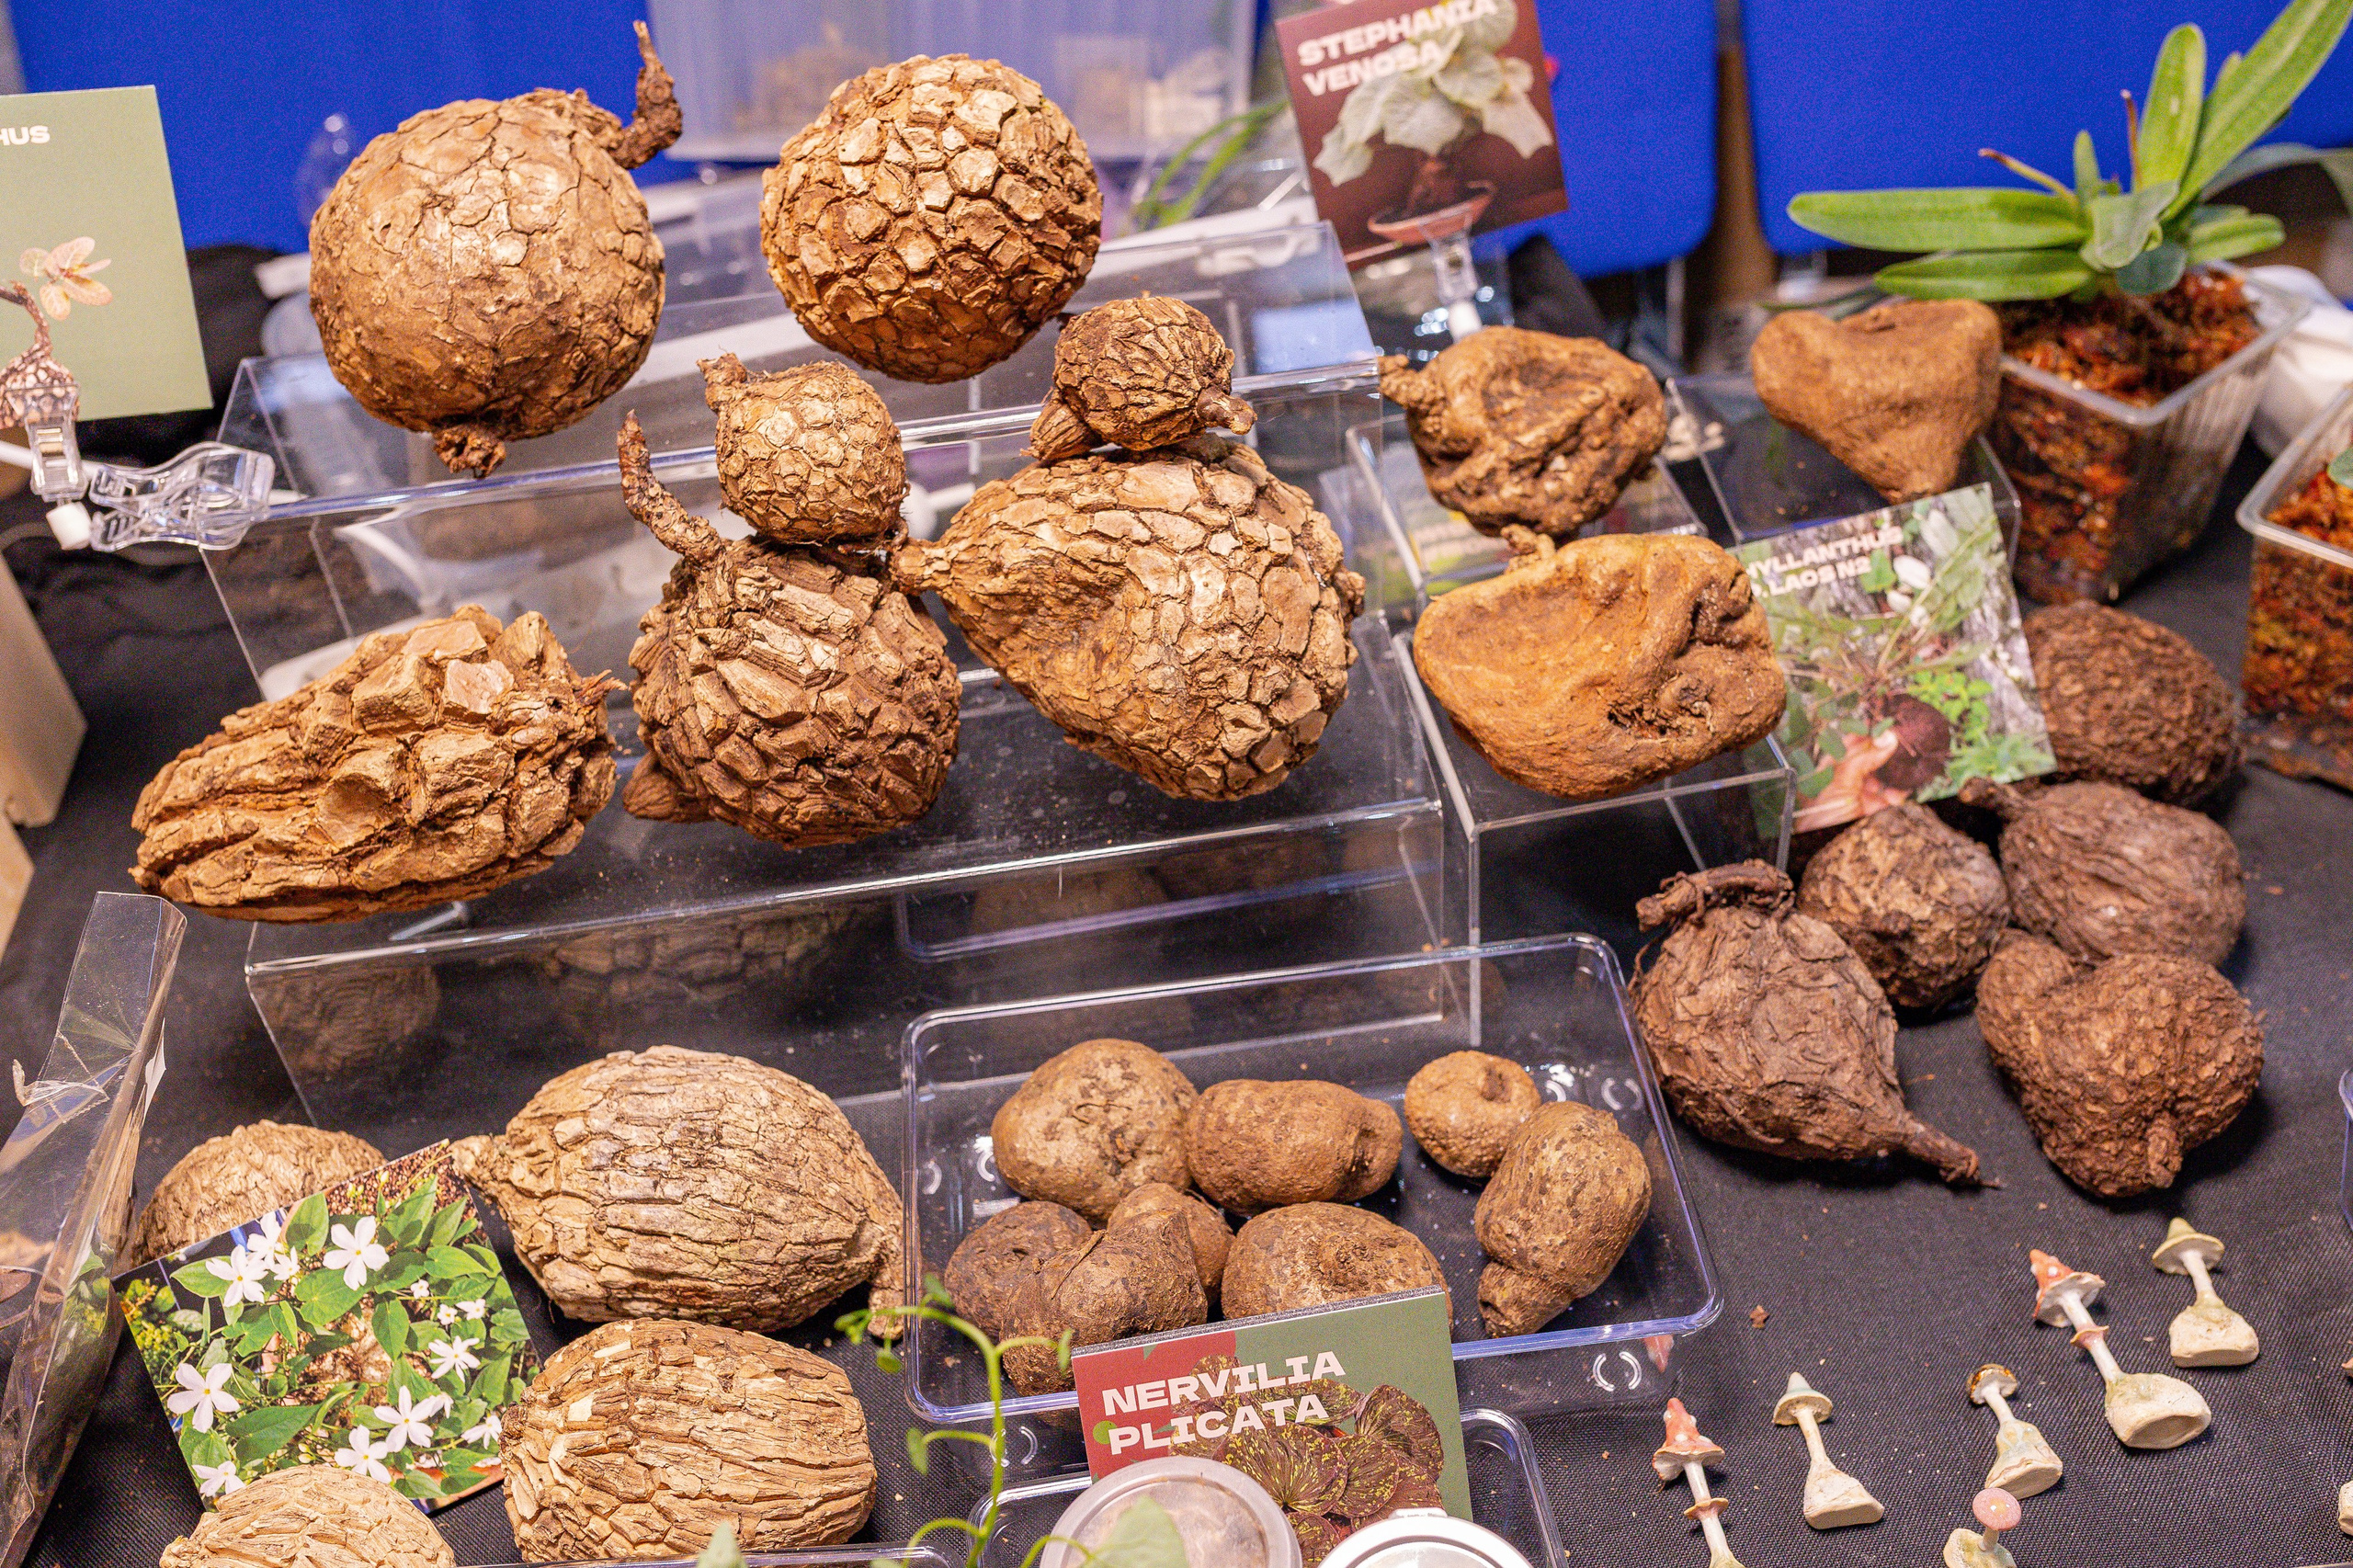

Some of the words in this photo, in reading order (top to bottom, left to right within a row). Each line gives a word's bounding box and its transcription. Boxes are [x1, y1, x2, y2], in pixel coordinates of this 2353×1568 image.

[1297, 0, 1498, 66] STEPHANIA
[1302, 40, 1443, 97] VENOSA
[1769, 564, 1836, 596] LAOS
[1101, 1351, 1347, 1416] NERVILIA
[1108, 1394, 1330, 1455] PLICATA
